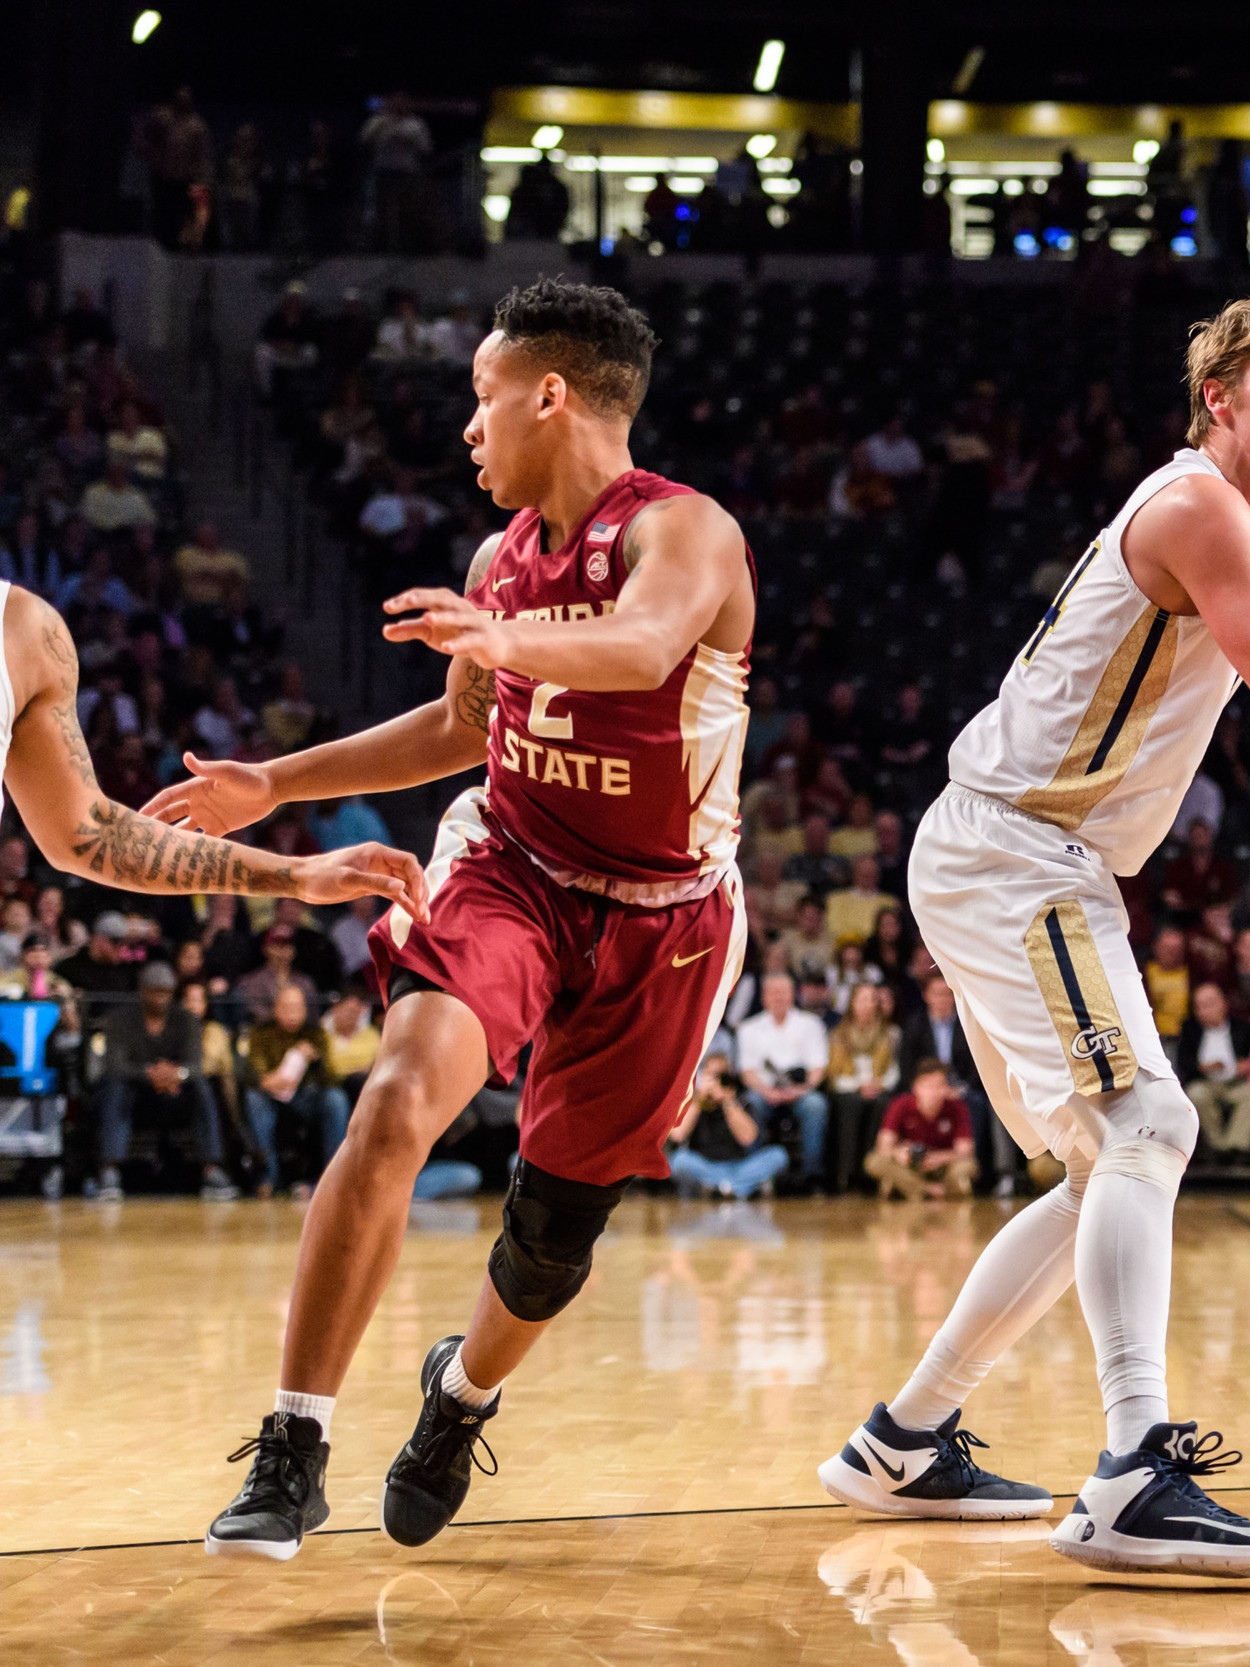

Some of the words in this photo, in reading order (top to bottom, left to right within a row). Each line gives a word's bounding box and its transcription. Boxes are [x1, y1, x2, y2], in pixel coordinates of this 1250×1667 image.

[528, 682, 574, 739] 2
[501, 727, 631, 796] STATE
[1071, 1024, 1121, 1060] GT
